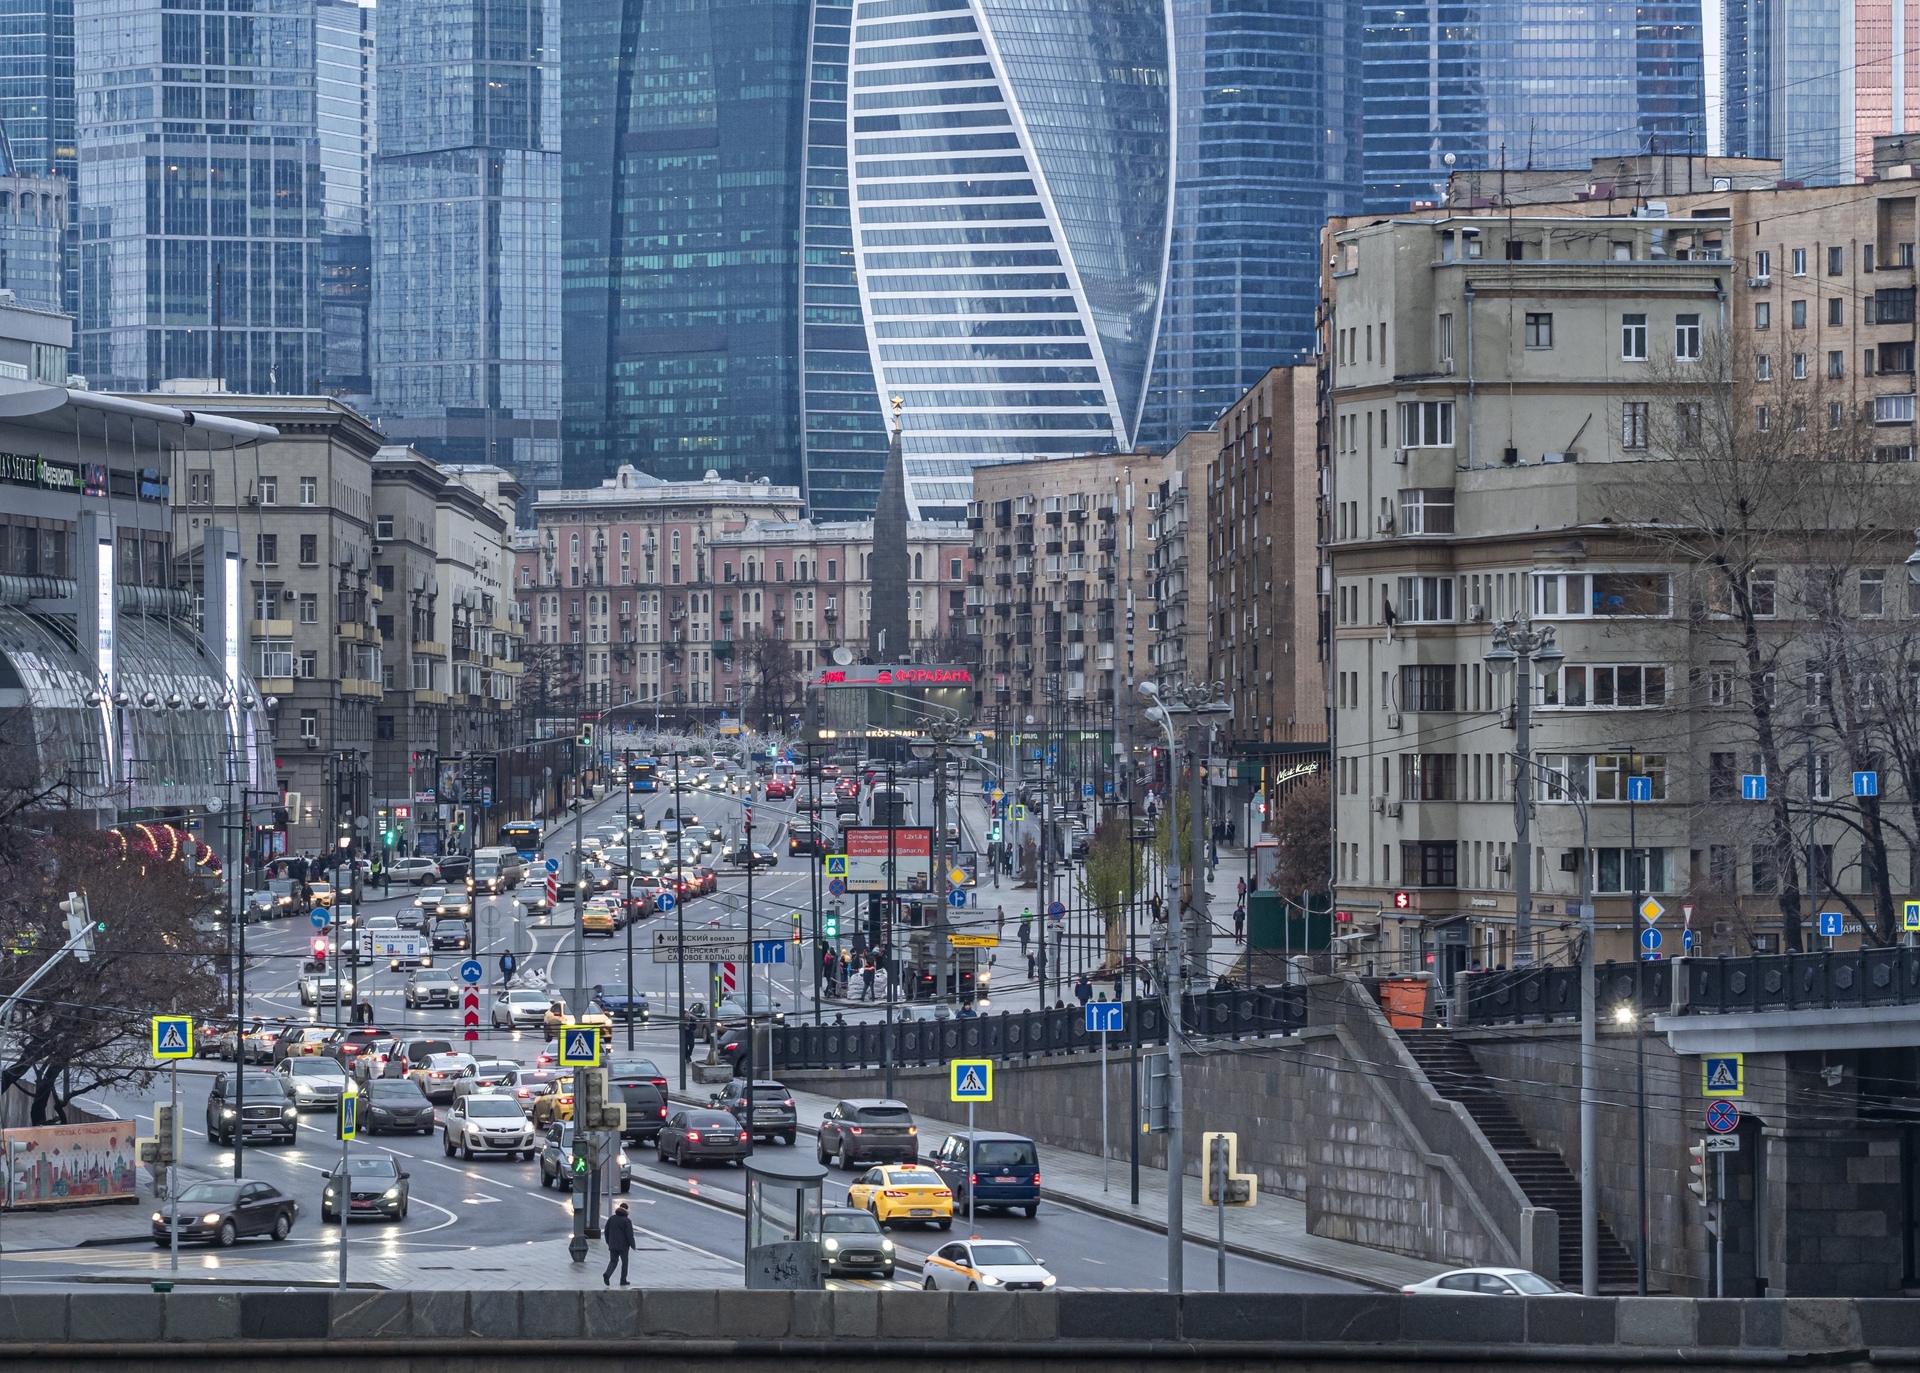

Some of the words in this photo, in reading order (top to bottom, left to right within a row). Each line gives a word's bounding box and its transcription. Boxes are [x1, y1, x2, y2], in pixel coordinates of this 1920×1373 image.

[12, 454, 36, 481] SECRET
[895, 669, 972, 682] ФОРАБАНК
[1276, 768, 1295, 782] Мак
[1295, 760, 1319, 775] Кафе
[1396, 893, 1408, 908] $
[704, 954, 736, 962] КОЛЬЦО
